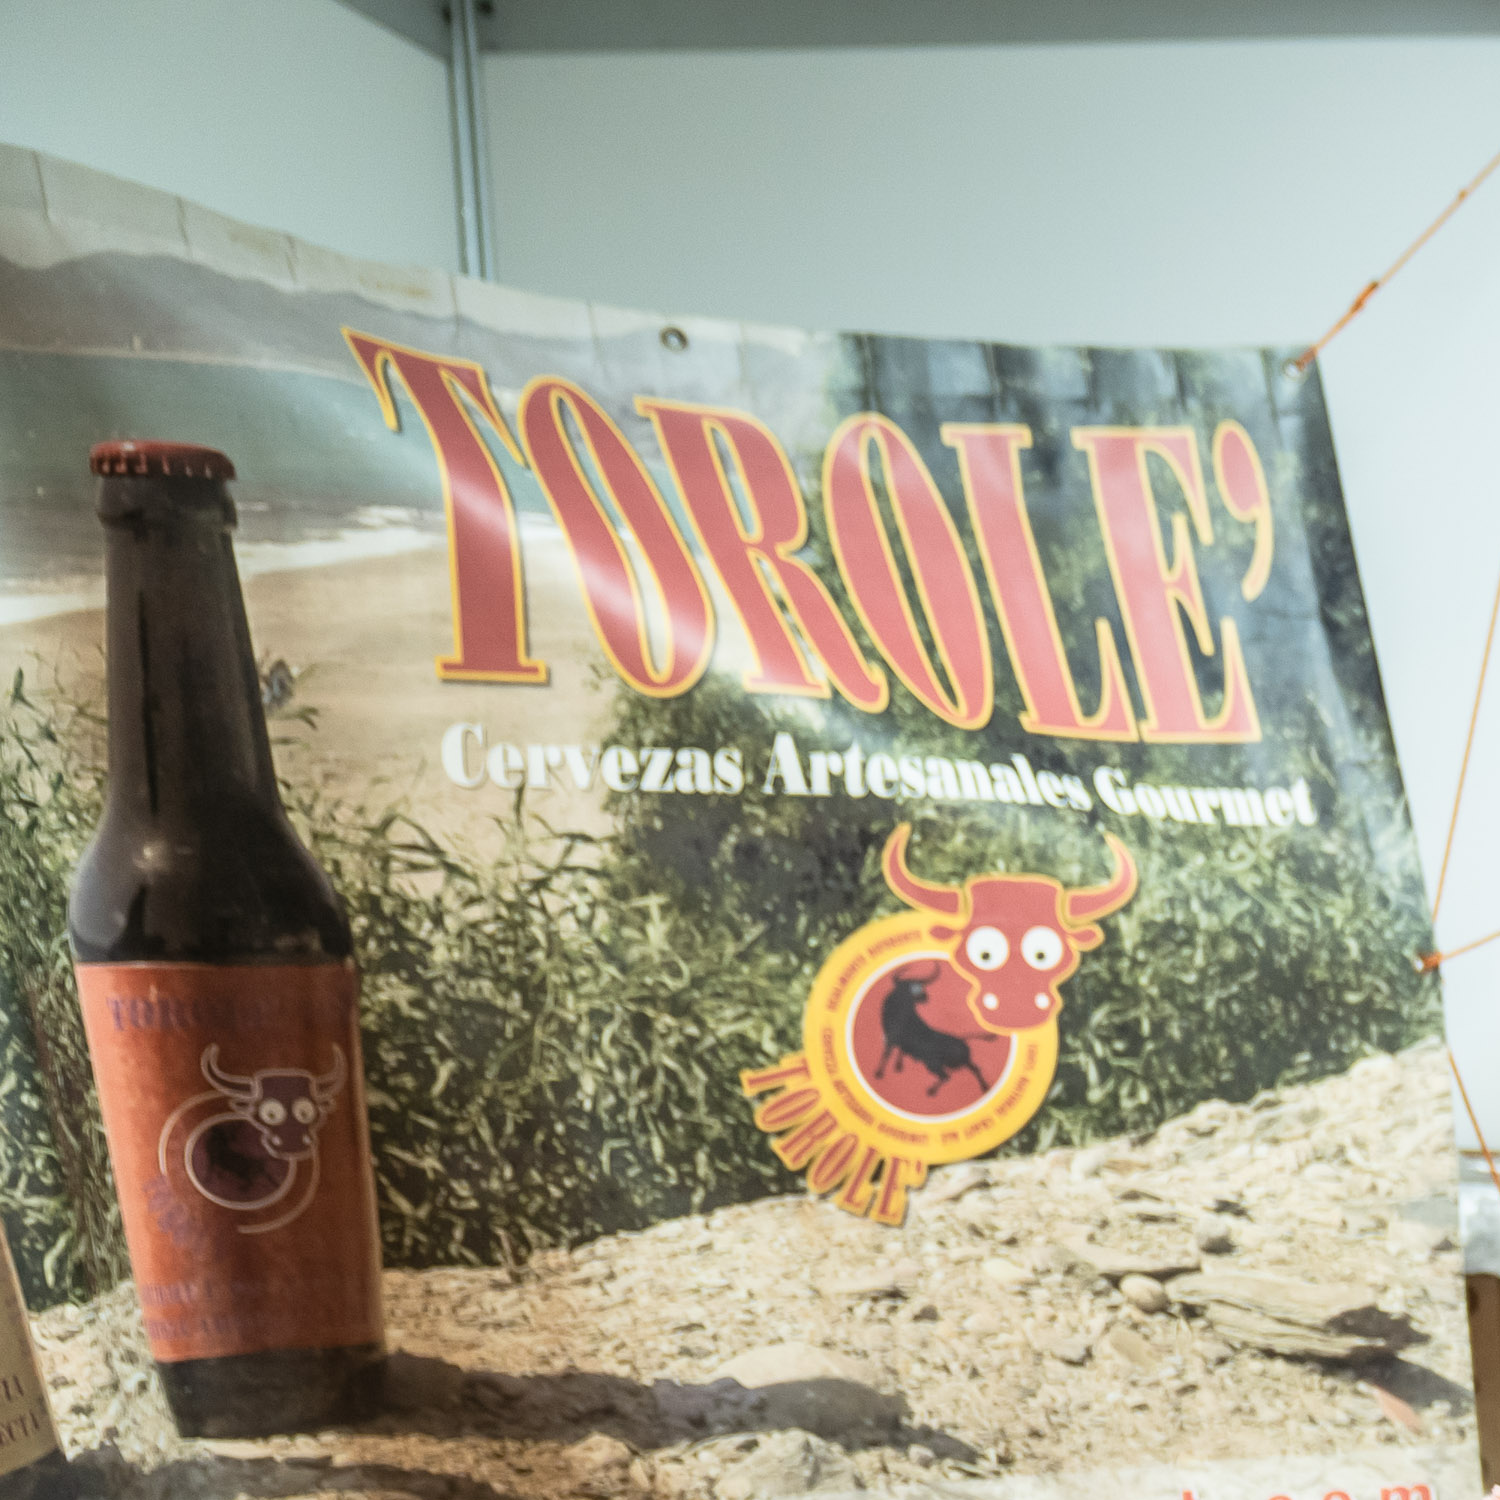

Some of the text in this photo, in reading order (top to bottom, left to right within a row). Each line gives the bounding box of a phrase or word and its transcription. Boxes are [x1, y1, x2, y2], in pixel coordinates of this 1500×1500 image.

[440, 721, 1319, 831] Cervezas Artesanales Gourmet
